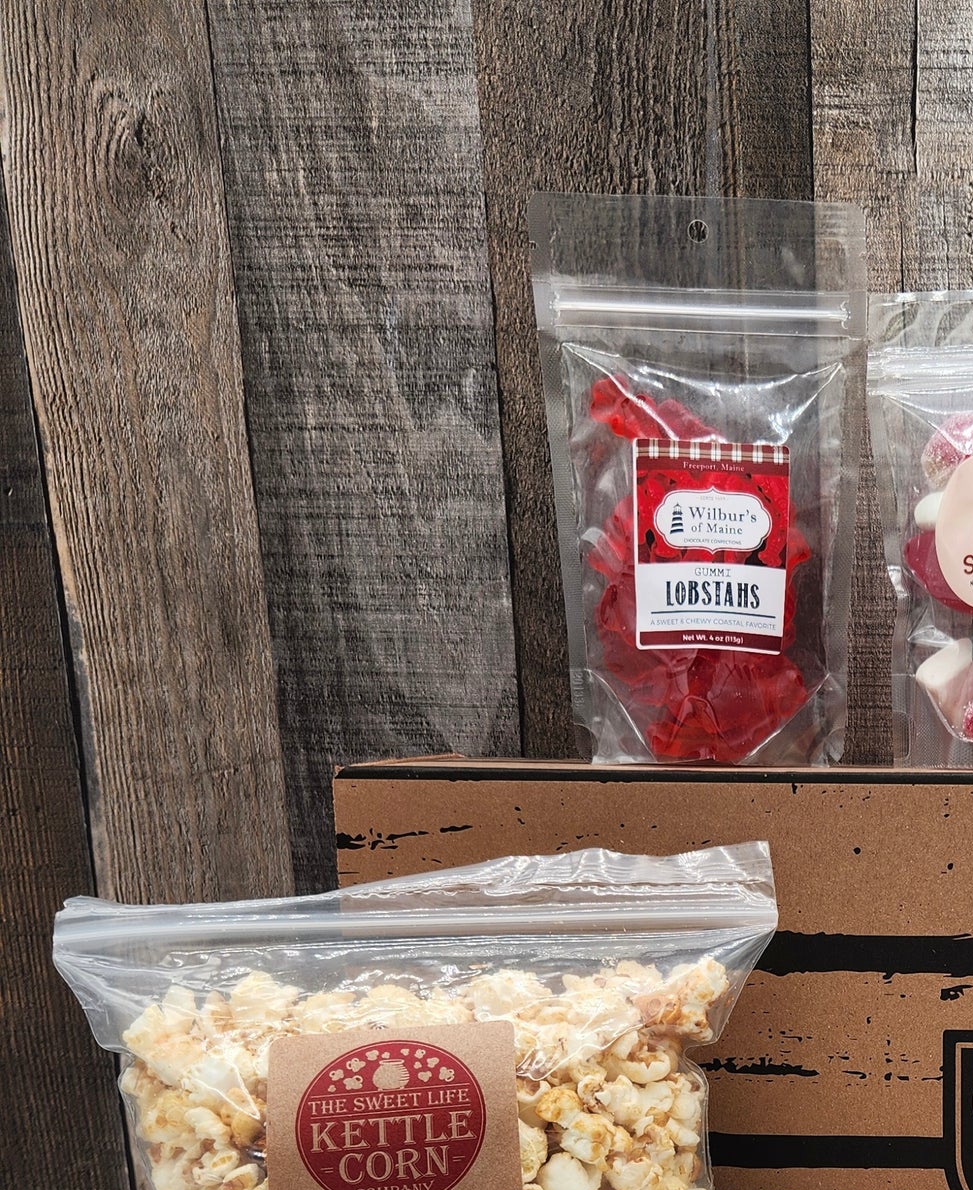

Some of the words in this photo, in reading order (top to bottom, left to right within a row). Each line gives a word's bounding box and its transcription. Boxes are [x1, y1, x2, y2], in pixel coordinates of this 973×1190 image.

[683, 461, 719, 471] Freeport,
[721, 464, 745, 472] Maine
[689, 506, 757, 523] Wilbur's
[691, 524, 703, 534] of
[707, 523, 743, 535] Maine
[695, 568, 731, 577] GUMMI
[666, 581, 760, 609] LOBSTAHS
[713, 618, 744, 627] COASTAL
[745, 621, 776, 630] FAVORITE
[725, 636, 743, 644] (113g)
[308, 1099, 347, 1115] THE
[353, 1092, 422, 1112] SWEET
[427, 1089, 469, 1105] LIFE
[310, 1110, 477, 1153] KETTLE
[339, 1145, 449, 1184] CORN
